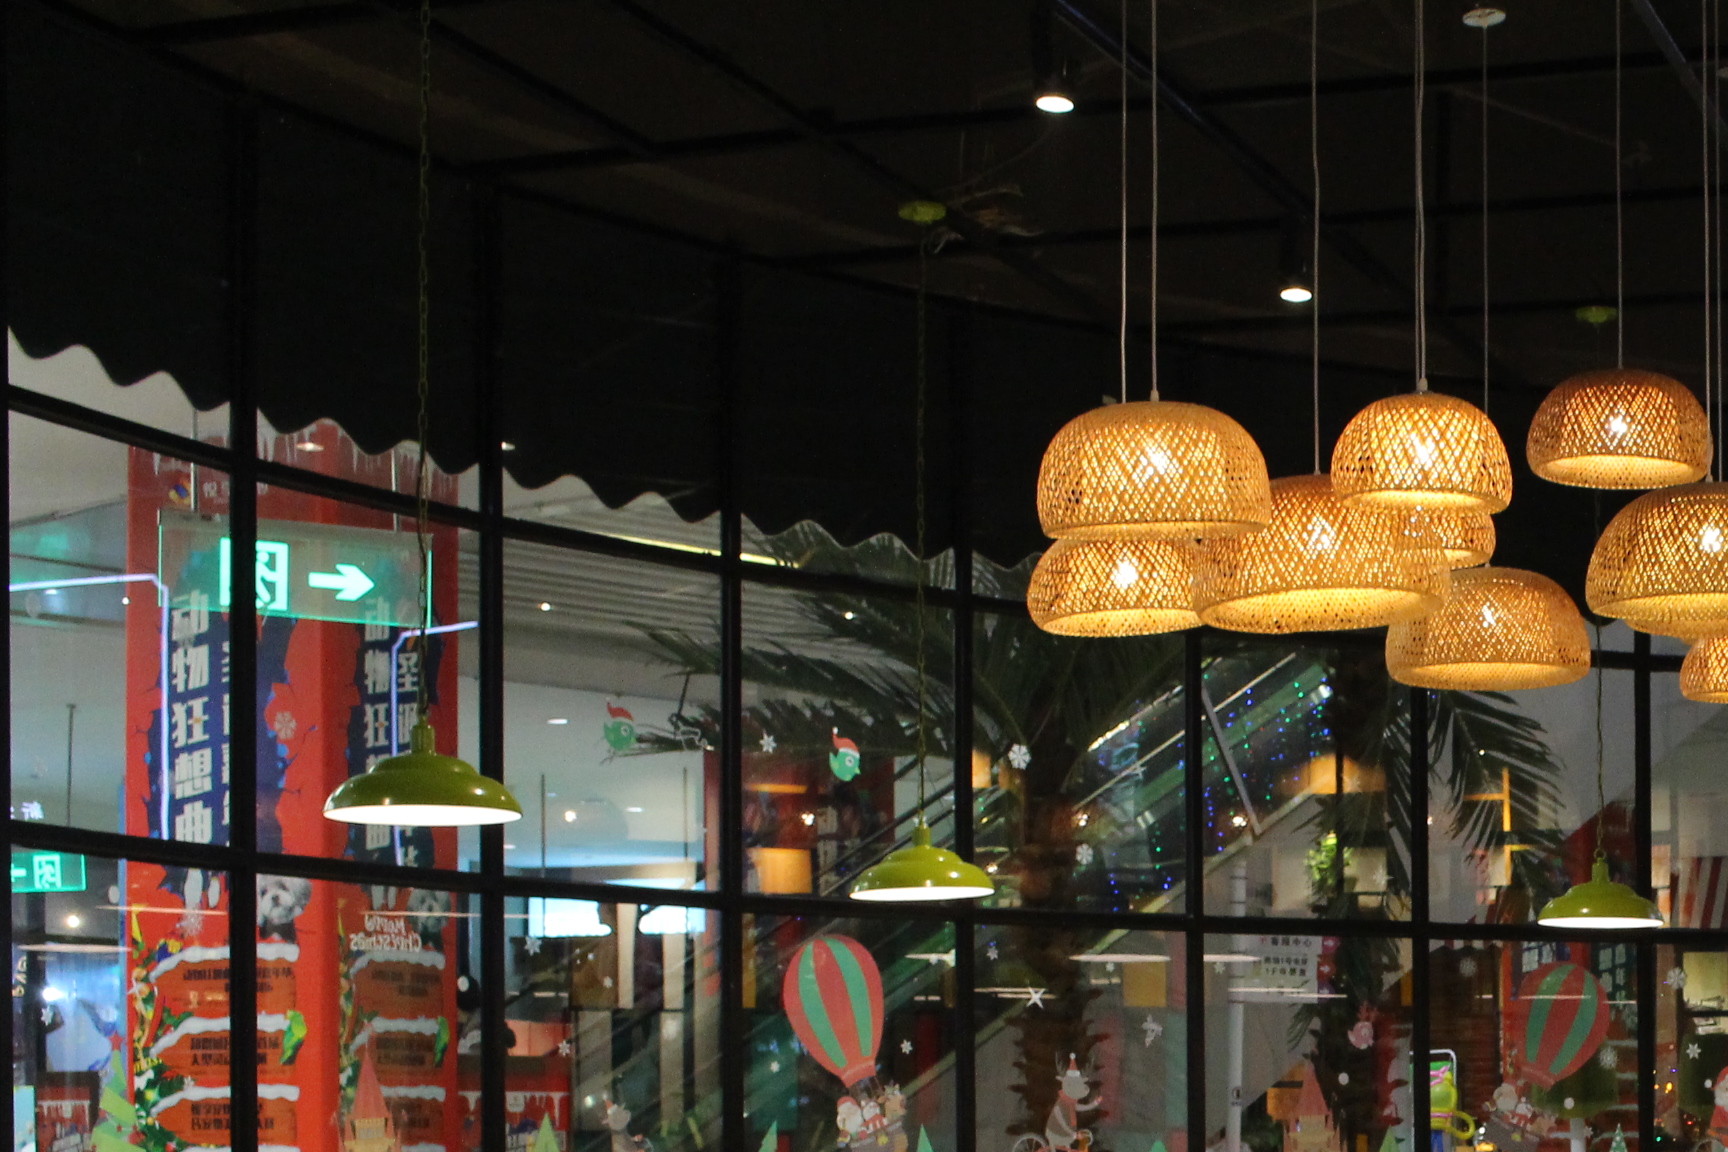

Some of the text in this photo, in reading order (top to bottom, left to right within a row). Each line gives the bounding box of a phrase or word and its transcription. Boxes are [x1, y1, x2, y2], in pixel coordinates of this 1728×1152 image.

[172, 589, 213, 845] 动物狂想曲
